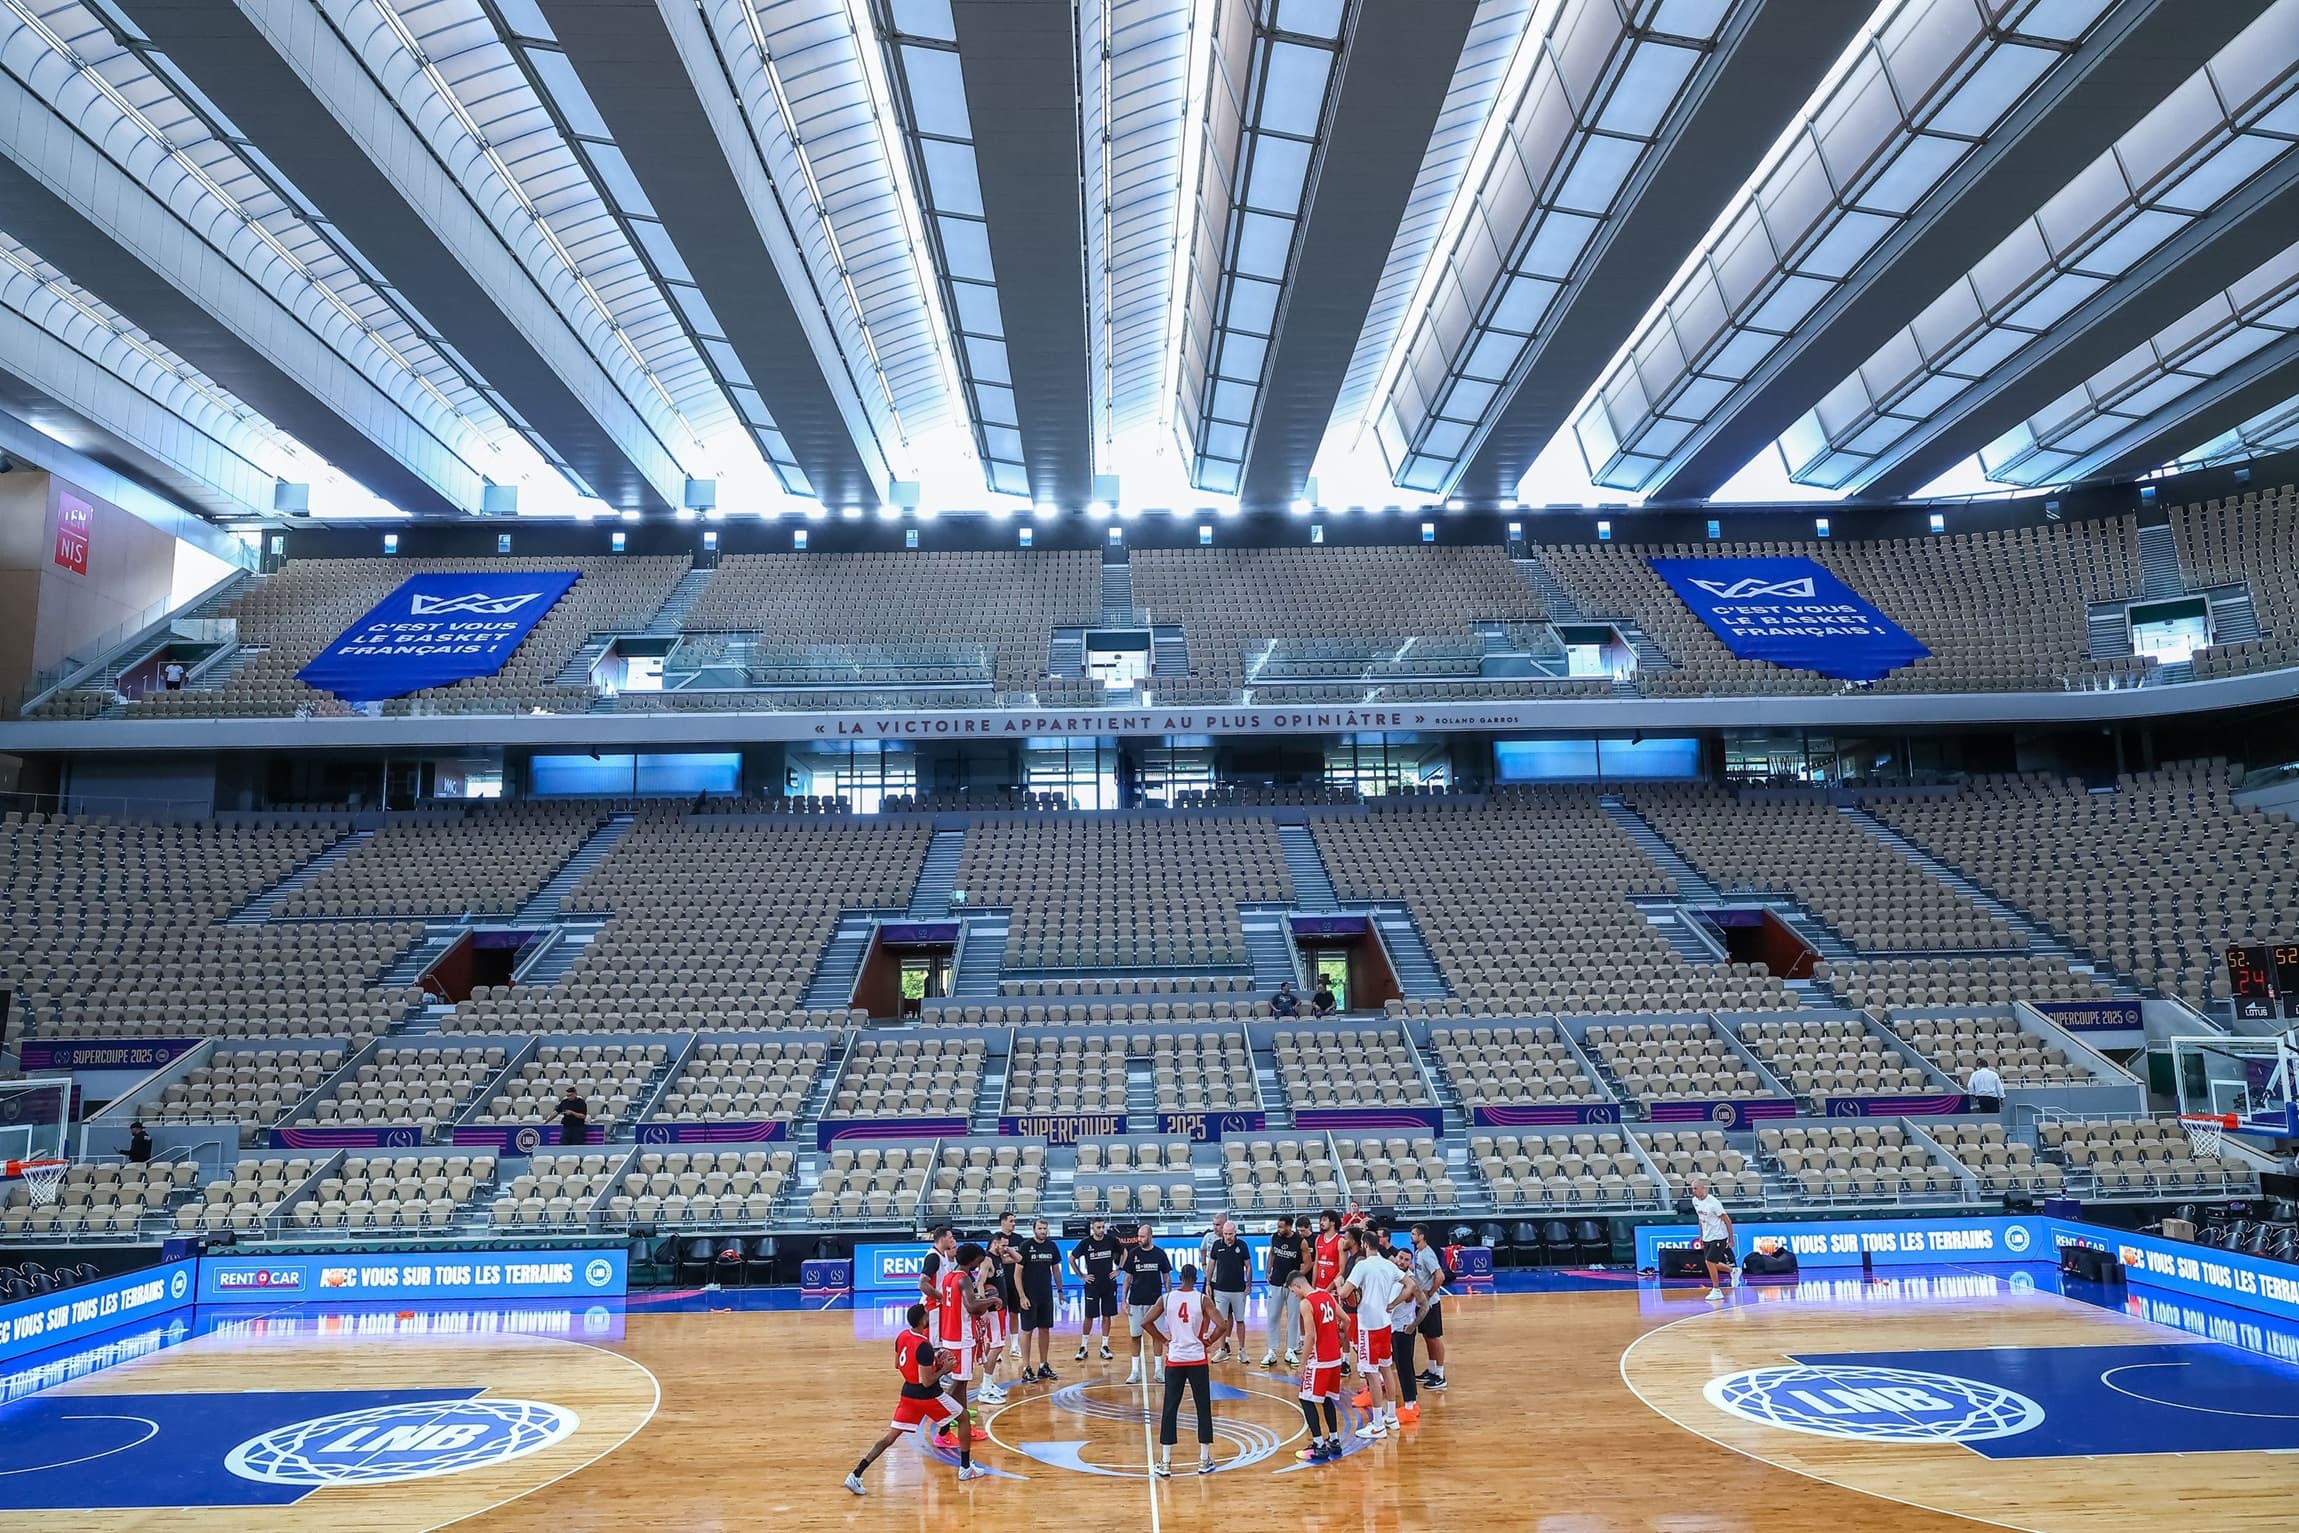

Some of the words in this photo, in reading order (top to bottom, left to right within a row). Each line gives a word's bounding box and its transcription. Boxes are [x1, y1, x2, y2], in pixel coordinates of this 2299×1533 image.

[61, 537, 83, 563] NIS
[1711, 605, 1780, 615] C'EST
[1789, 604, 1857, 613] VOUS
[1720, 617, 1752, 625] LE
[1761, 615, 1868, 624] BASKET
[368, 622, 444, 632] C'EST
[449, 622, 519, 631] VOUS
[1731, 626, 1870, 637] FRANÇAIS
[352, 634, 388, 643] LE
[394, 633, 510, 643] BASKET
[337, 645, 482, 656] FRANÇAIS
[838, 721, 863, 734] LA
[877, 719, 992, 733] VICTOIRE
[1004, 717, 1152, 731] APPARTIENT
[1164, 716, 1193, 729] AU
[1206, 715, 1261, 729] PLUS
[1273, 710, 1402, 728] OPINIÂTRE
[1479, 716, 1519, 724] GARROS
[2275, 947, 2298, 965] 52
[2239, 969, 2265, 994] 24
[2102, 1010, 2123, 1025] 2025
[2245, 1008, 2268, 1017] LOTUS
[73, 1050, 128, 1064] SUPERCOUPE
[131, 1049, 153, 1063] 2025
[1018, 1115, 1119, 1144] SUPERCOUPE
[1167, 1114, 1207, 1140] 2025
[1790, 1235, 1828, 1254] VOUS
[1831, 1234, 1859, 1253] SUR
[1861, 1232, 1897, 1252] TOUS
[1899, 1230, 1925, 1251] LES
[1927, 1229, 1994, 1250] TERRAINS
[220, 1272, 256, 1285] RENT
[270, 1271, 299, 1284] CAR
[320, 1267, 357, 1287] AEC
[361, 1266, 399, 1286] VOUS
[402, 1266, 431, 1286] SUR
[435, 1265, 471, 1285] TOUS
[475, 1265, 501, 1285] LES
[505, 1263, 573, 1284] TERRAINS
[2118, 1245, 2146, 1269] AEC
[2146, 1250, 2176, 1276] VOUS
[2178, 1257, 2200, 1282] SUR
[2201, 1261, 2232, 1289] TOUS
[2234, 1267, 2257, 1295] LES
[2258, 1273, 2299, 1304] TERRA
[14, 1312, 44, 1341] VOUS
[47, 1304, 69, 1331] SUR
[72, 1298, 98, 1324] TOUS
[100, 1292, 118, 1316] LES
[121, 1279, 165, 1310] TERRAINS
[1178, 1302, 1189, 1323] 4
[1320, 1301, 1334, 1324] 26
[899, 1346, 907, 1367] 6
[1788, 1386, 1955, 1415] LNB
[317, 1424, 490, 1453] LNB
